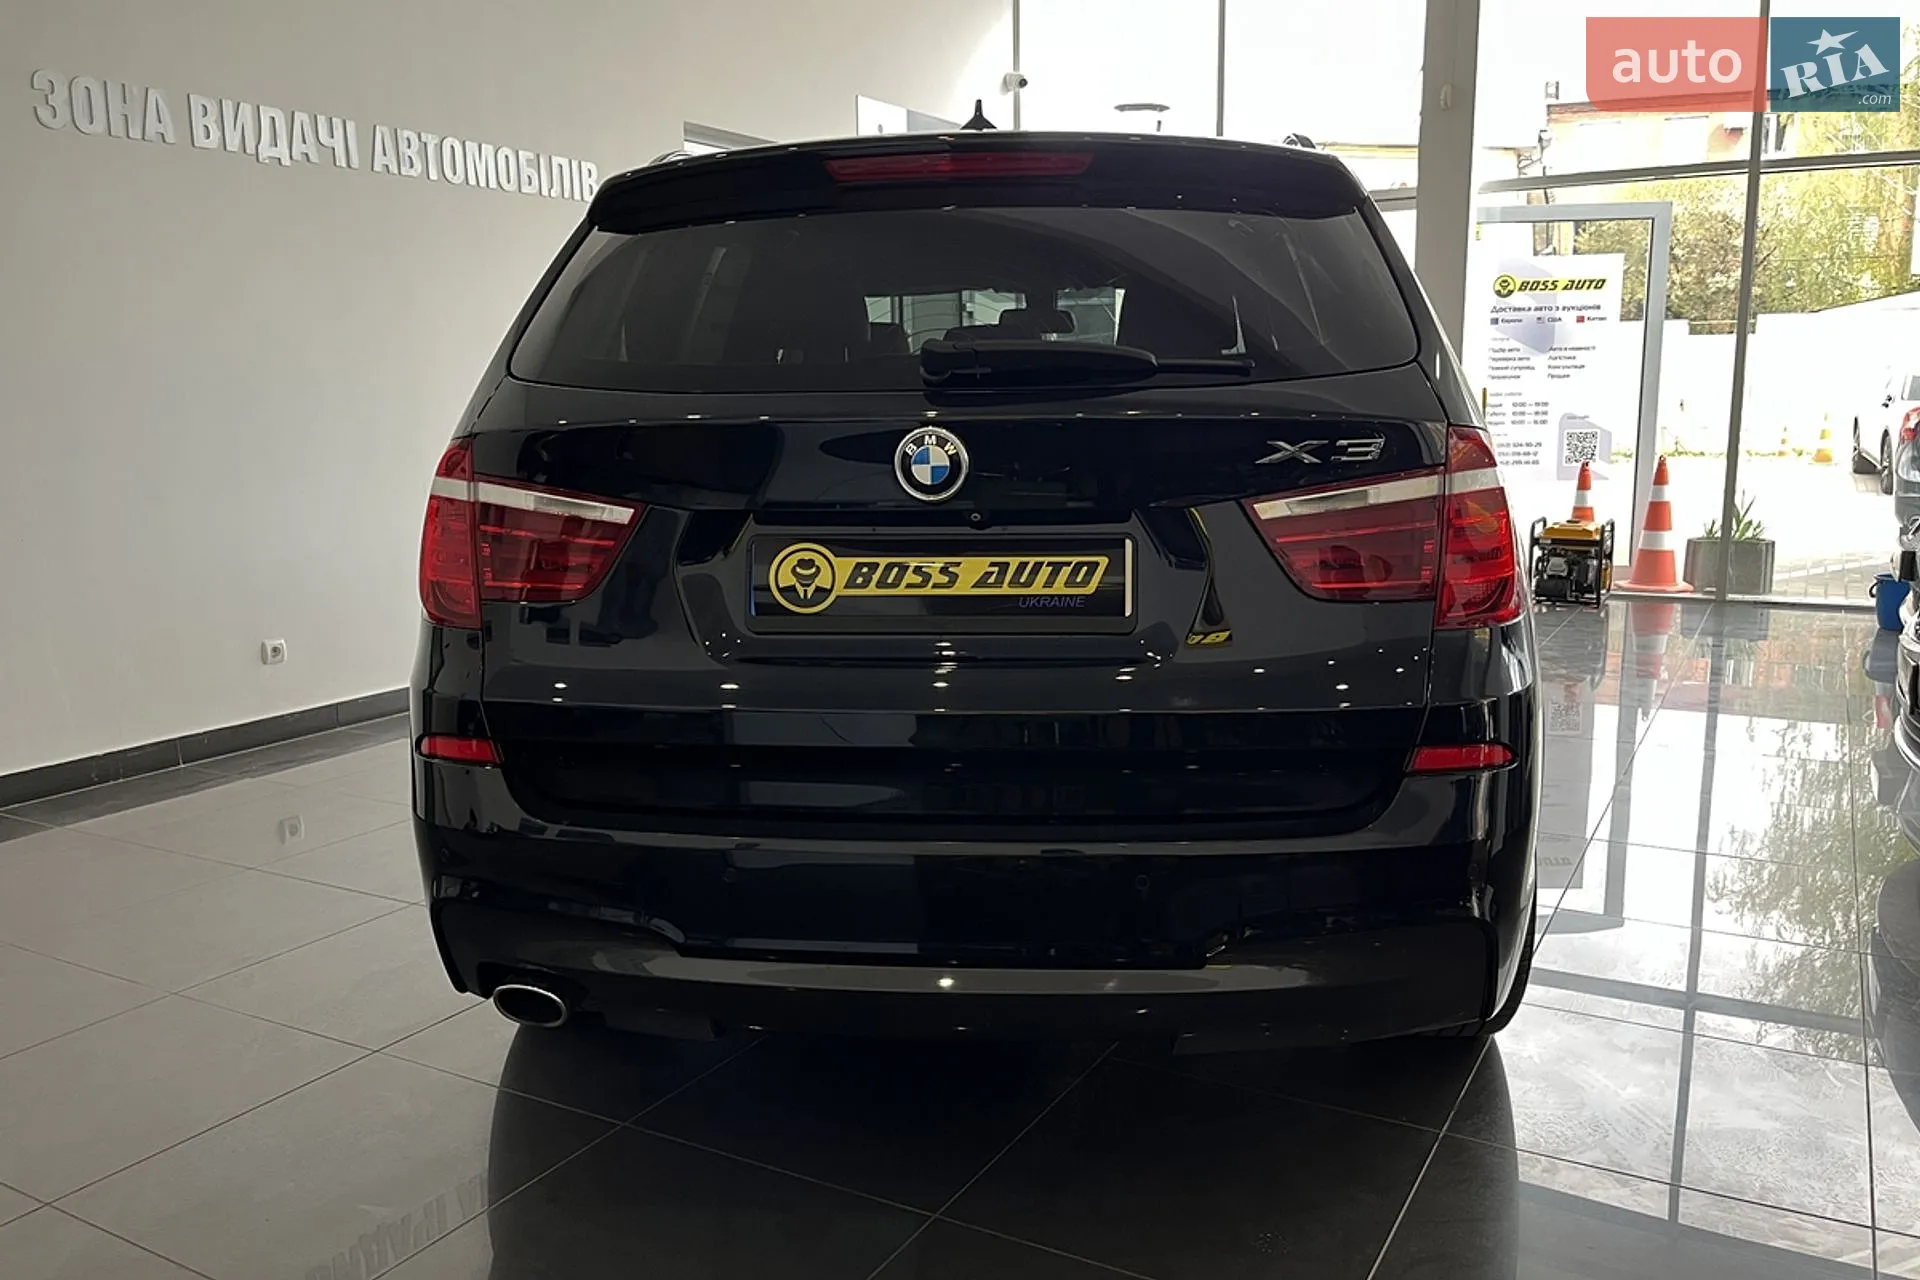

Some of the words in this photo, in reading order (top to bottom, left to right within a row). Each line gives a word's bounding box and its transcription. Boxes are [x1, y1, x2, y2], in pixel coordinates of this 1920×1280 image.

[30, 69, 176, 144] ЗОНА
[188, 93, 359, 170] ВИДАЧІ
[372, 124, 600, 203] АВТОМОБІЛІВ
[1517, 280, 1559, 292] BOSS
[1562, 278, 1607, 291] AUTO
[1490, 305, 1532, 314] Доставка
[1561, 304, 1601, 312] аукціонів
[905, 435, 957, 456] BMW
[1255, 438, 1386, 464] X3
[843, 561, 962, 589] BOSS
[970, 560, 1100, 589] AUTO
[1018, 596, 1086, 608] UKRAINE
